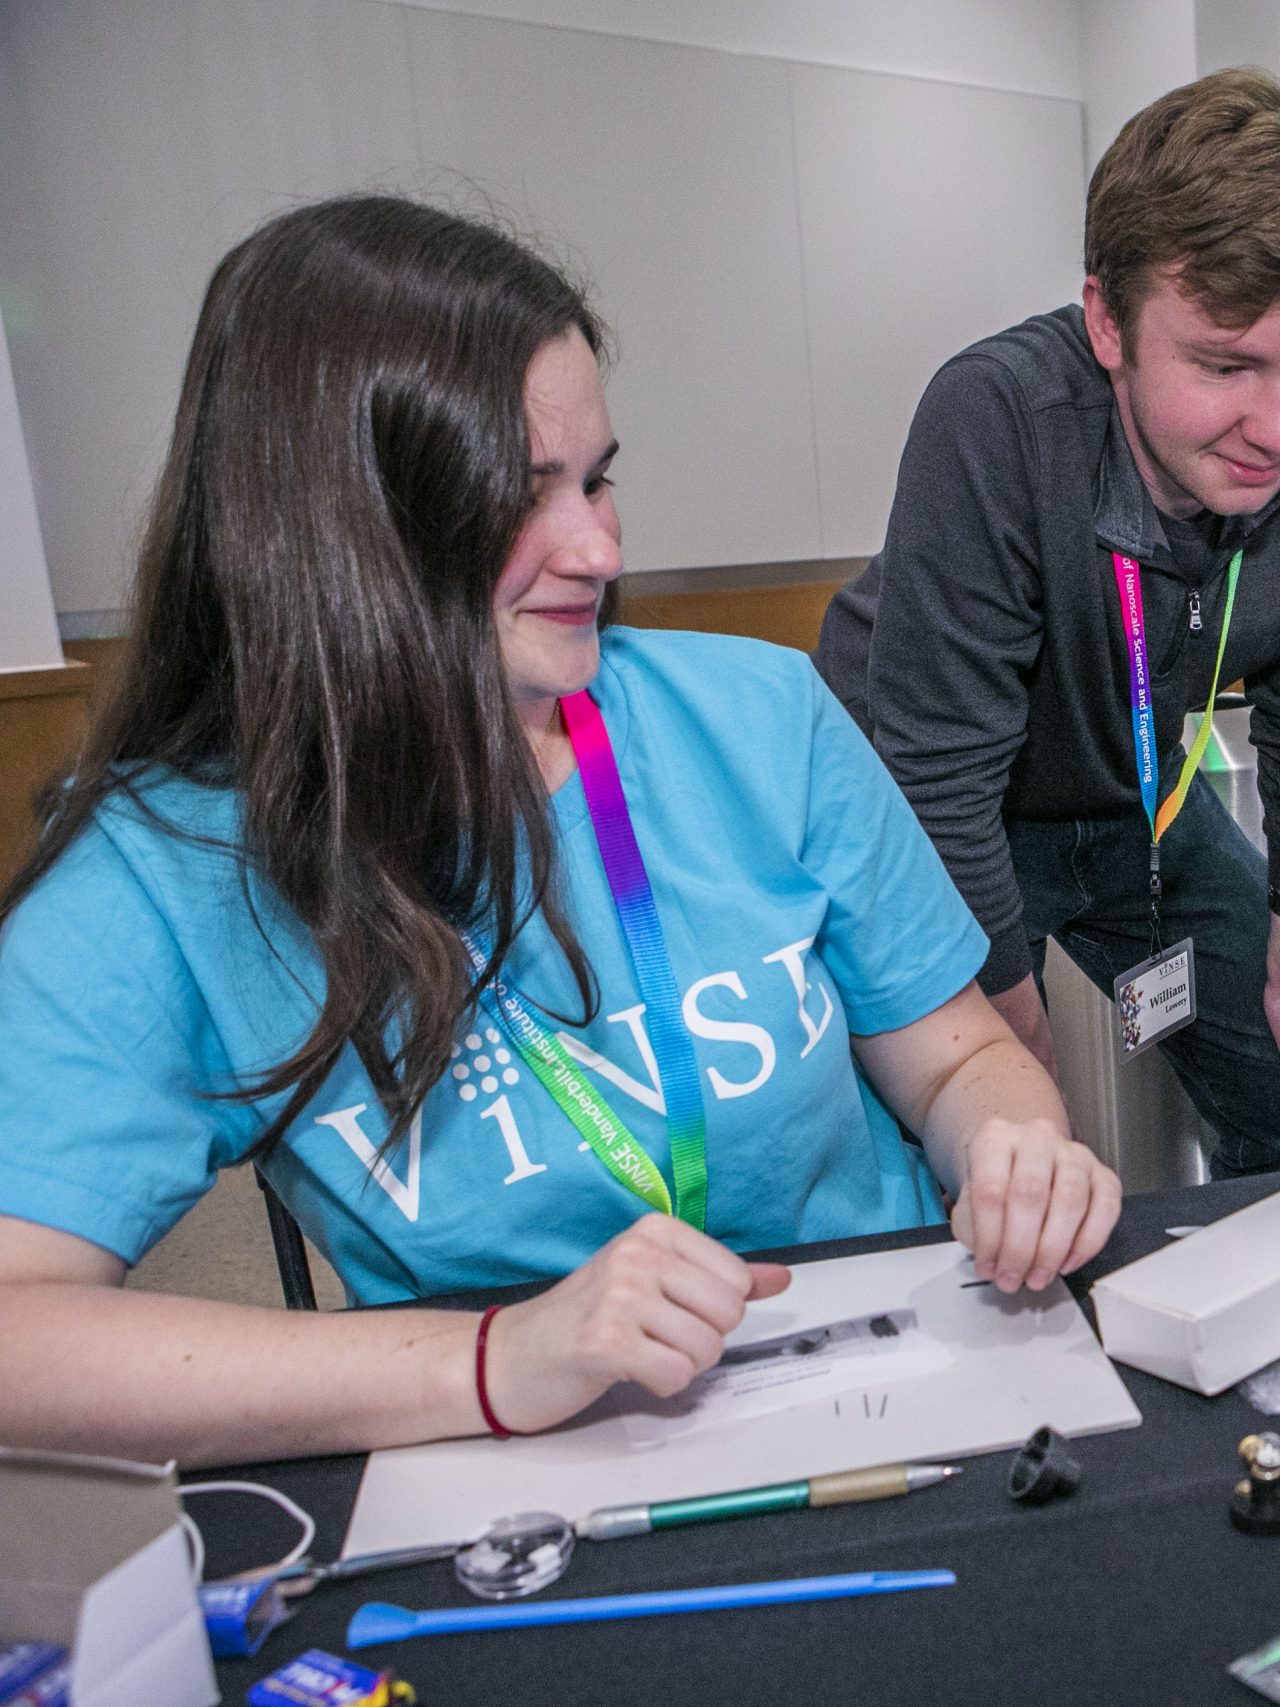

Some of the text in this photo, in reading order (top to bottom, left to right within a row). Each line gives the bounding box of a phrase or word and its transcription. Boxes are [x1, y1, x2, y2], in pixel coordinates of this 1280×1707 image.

[1122, 557, 1153, 784] of Nanoscale Science and Engineering
[1150, 983, 1186, 1009] William
[1165, 998, 1187, 1013] Lowery
[609, 1140, 655, 1194] VINSE
